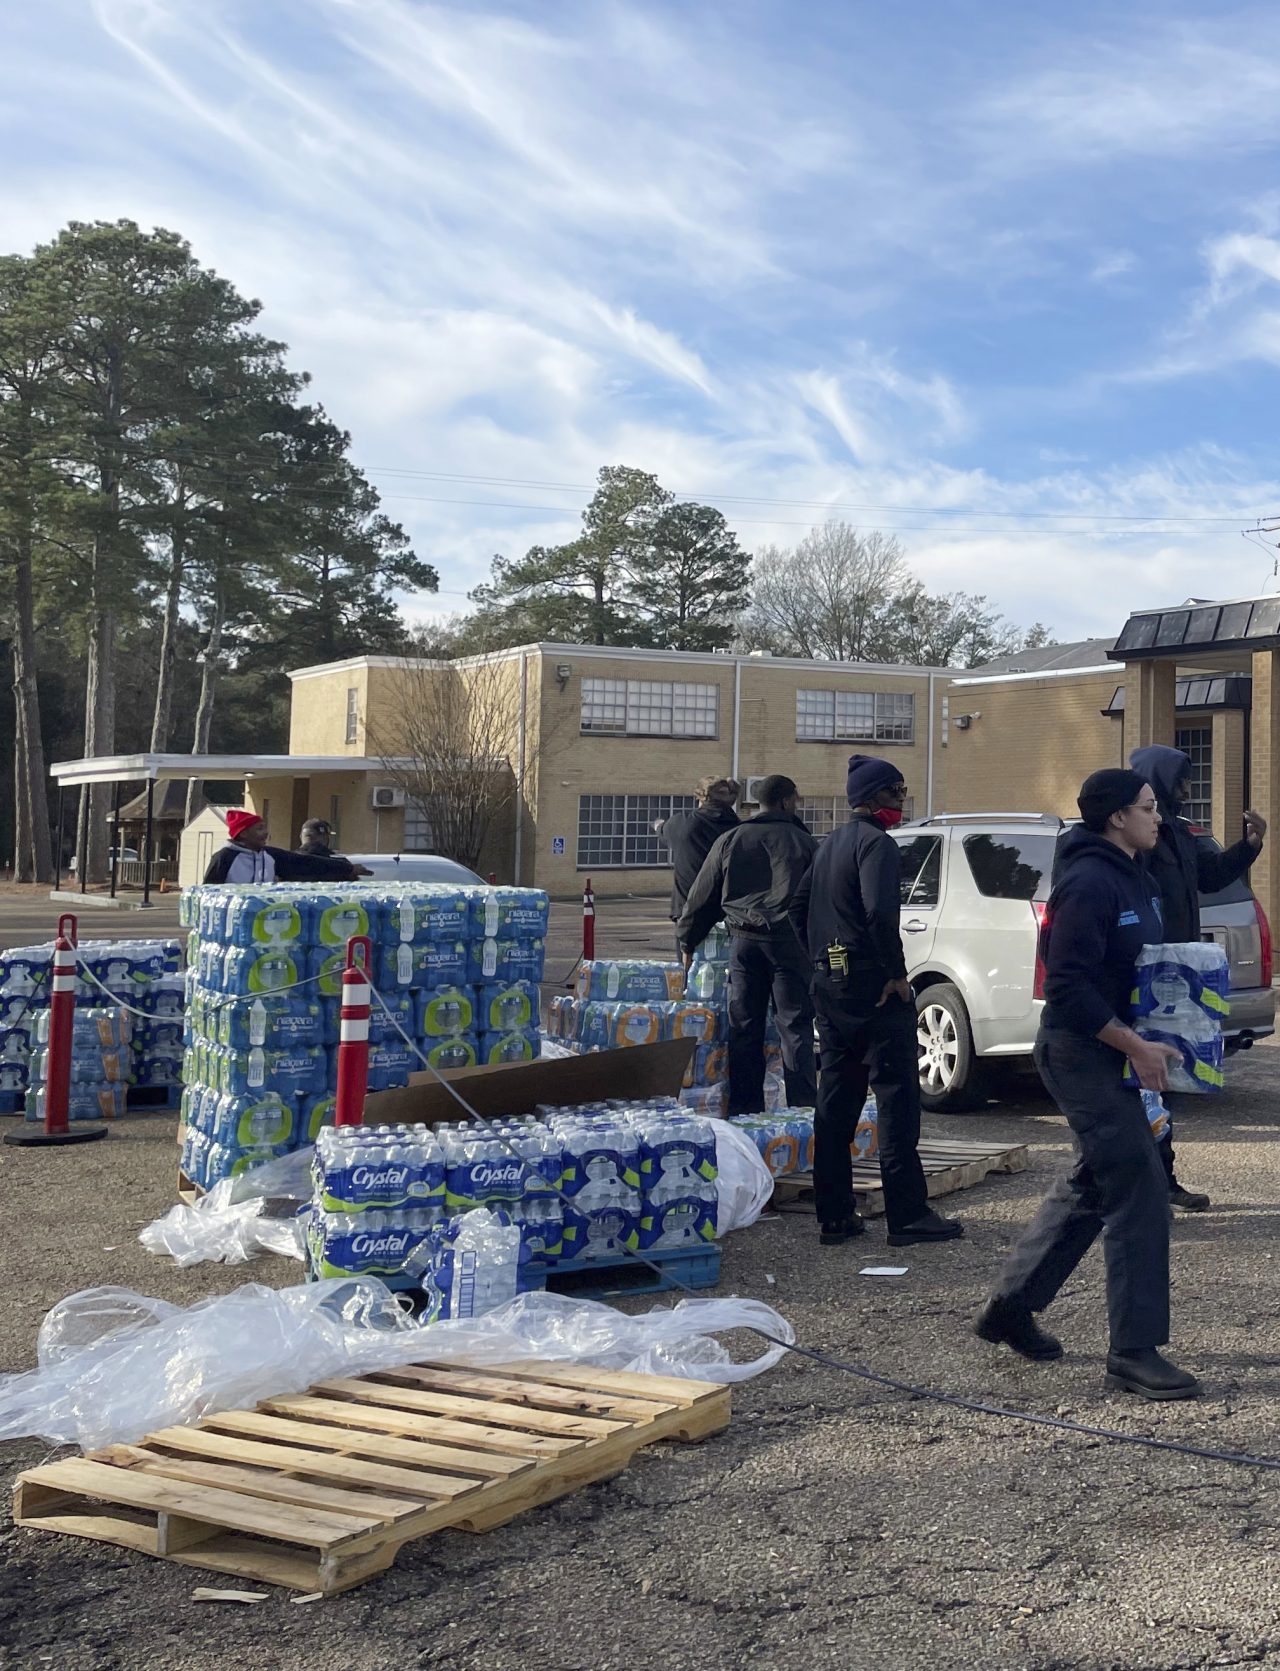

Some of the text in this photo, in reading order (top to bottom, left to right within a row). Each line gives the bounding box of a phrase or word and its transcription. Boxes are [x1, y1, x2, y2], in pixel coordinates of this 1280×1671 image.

[425, 912, 460, 926] niagara
[508, 909, 540, 922] niagara
[423, 953, 458, 966] niagara
[276, 1016, 313, 1029] niagara
[275, 1058, 312, 1071] niagara
[372, 1052, 408, 1065] niagara
[352, 1166, 409, 1190] Crystal
[470, 1163, 525, 1186] Crystal
[352, 1233, 409, 1257] Crystal
